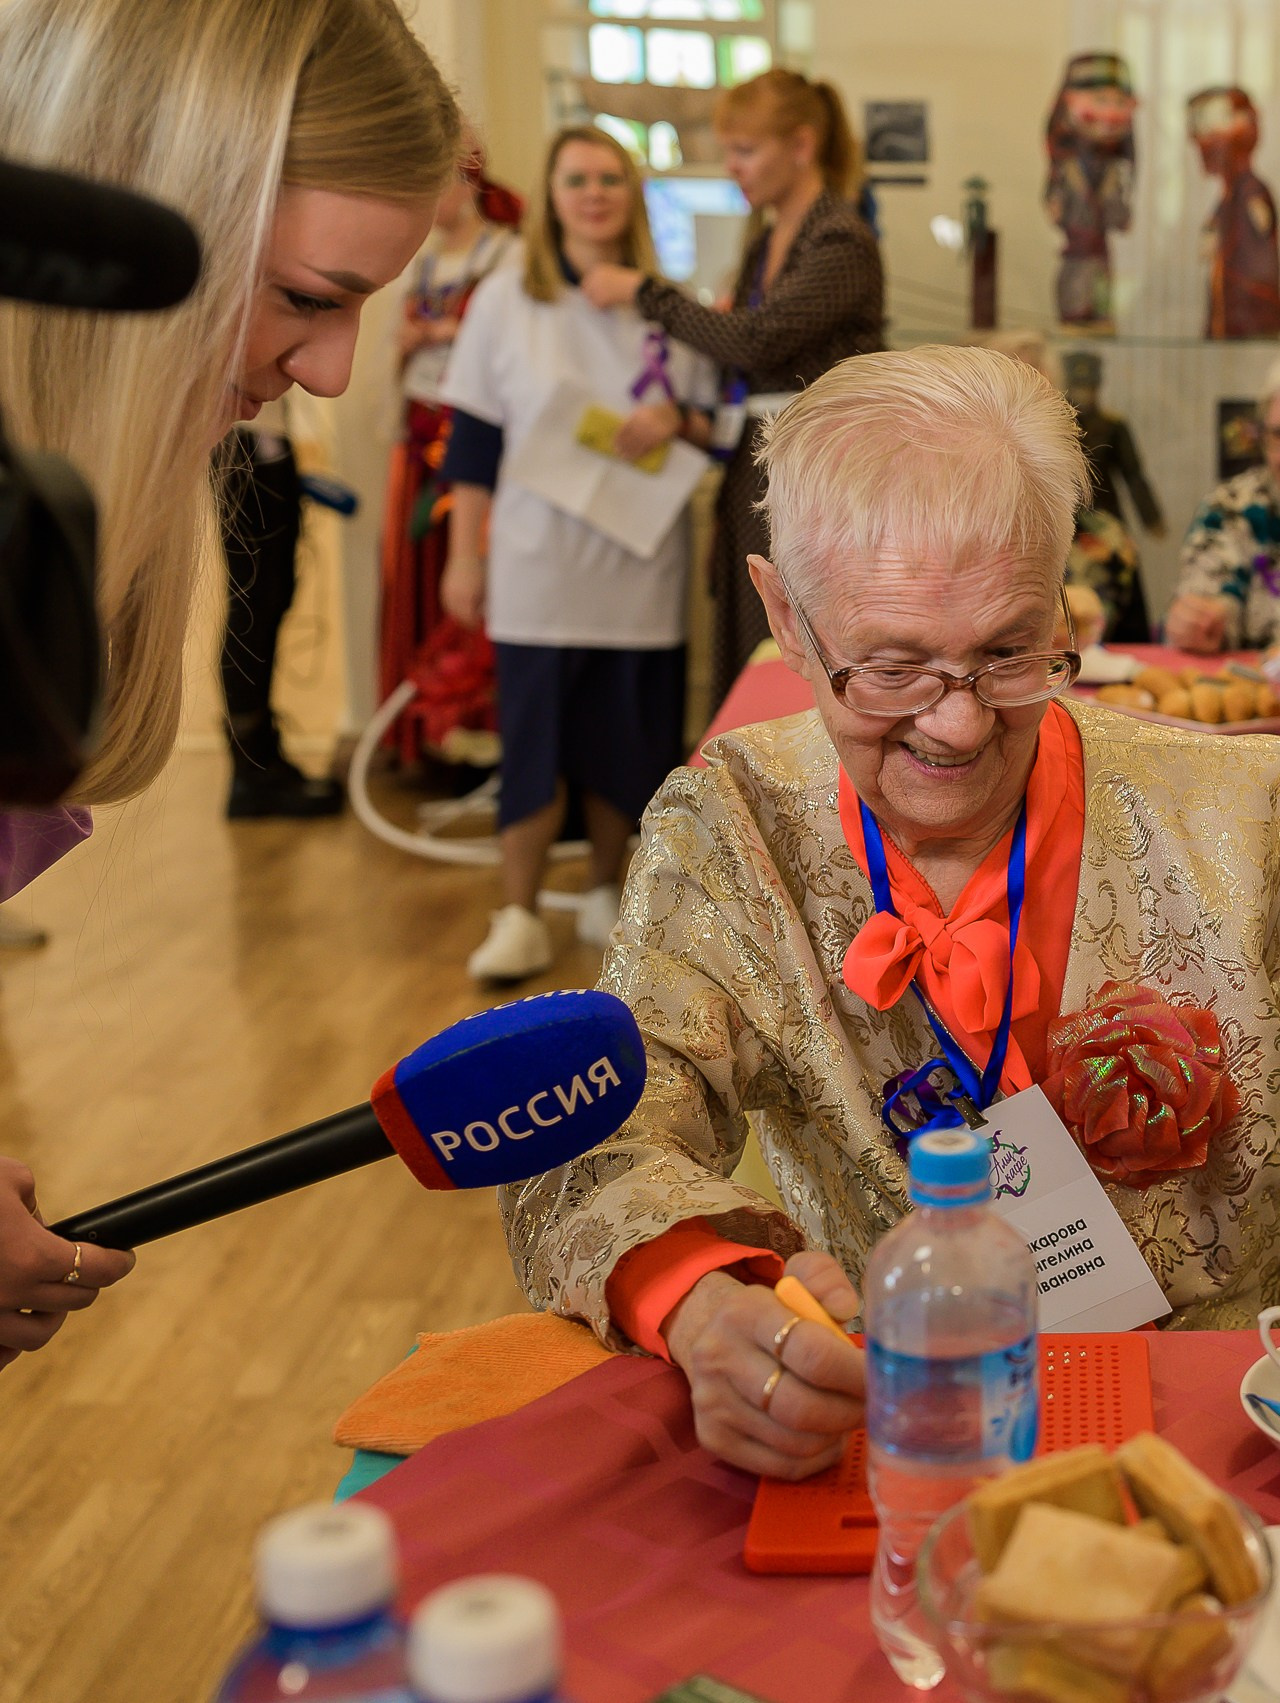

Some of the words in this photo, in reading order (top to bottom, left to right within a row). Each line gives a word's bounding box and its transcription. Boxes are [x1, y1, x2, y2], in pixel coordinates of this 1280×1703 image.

[430, 1056, 622, 1162] РОССИЯ
[1004, 1155, 1028, 1184] кафе
[1026, 1218, 1088, 1254] карова
[1033, 1238, 1095, 1274] нгелина
